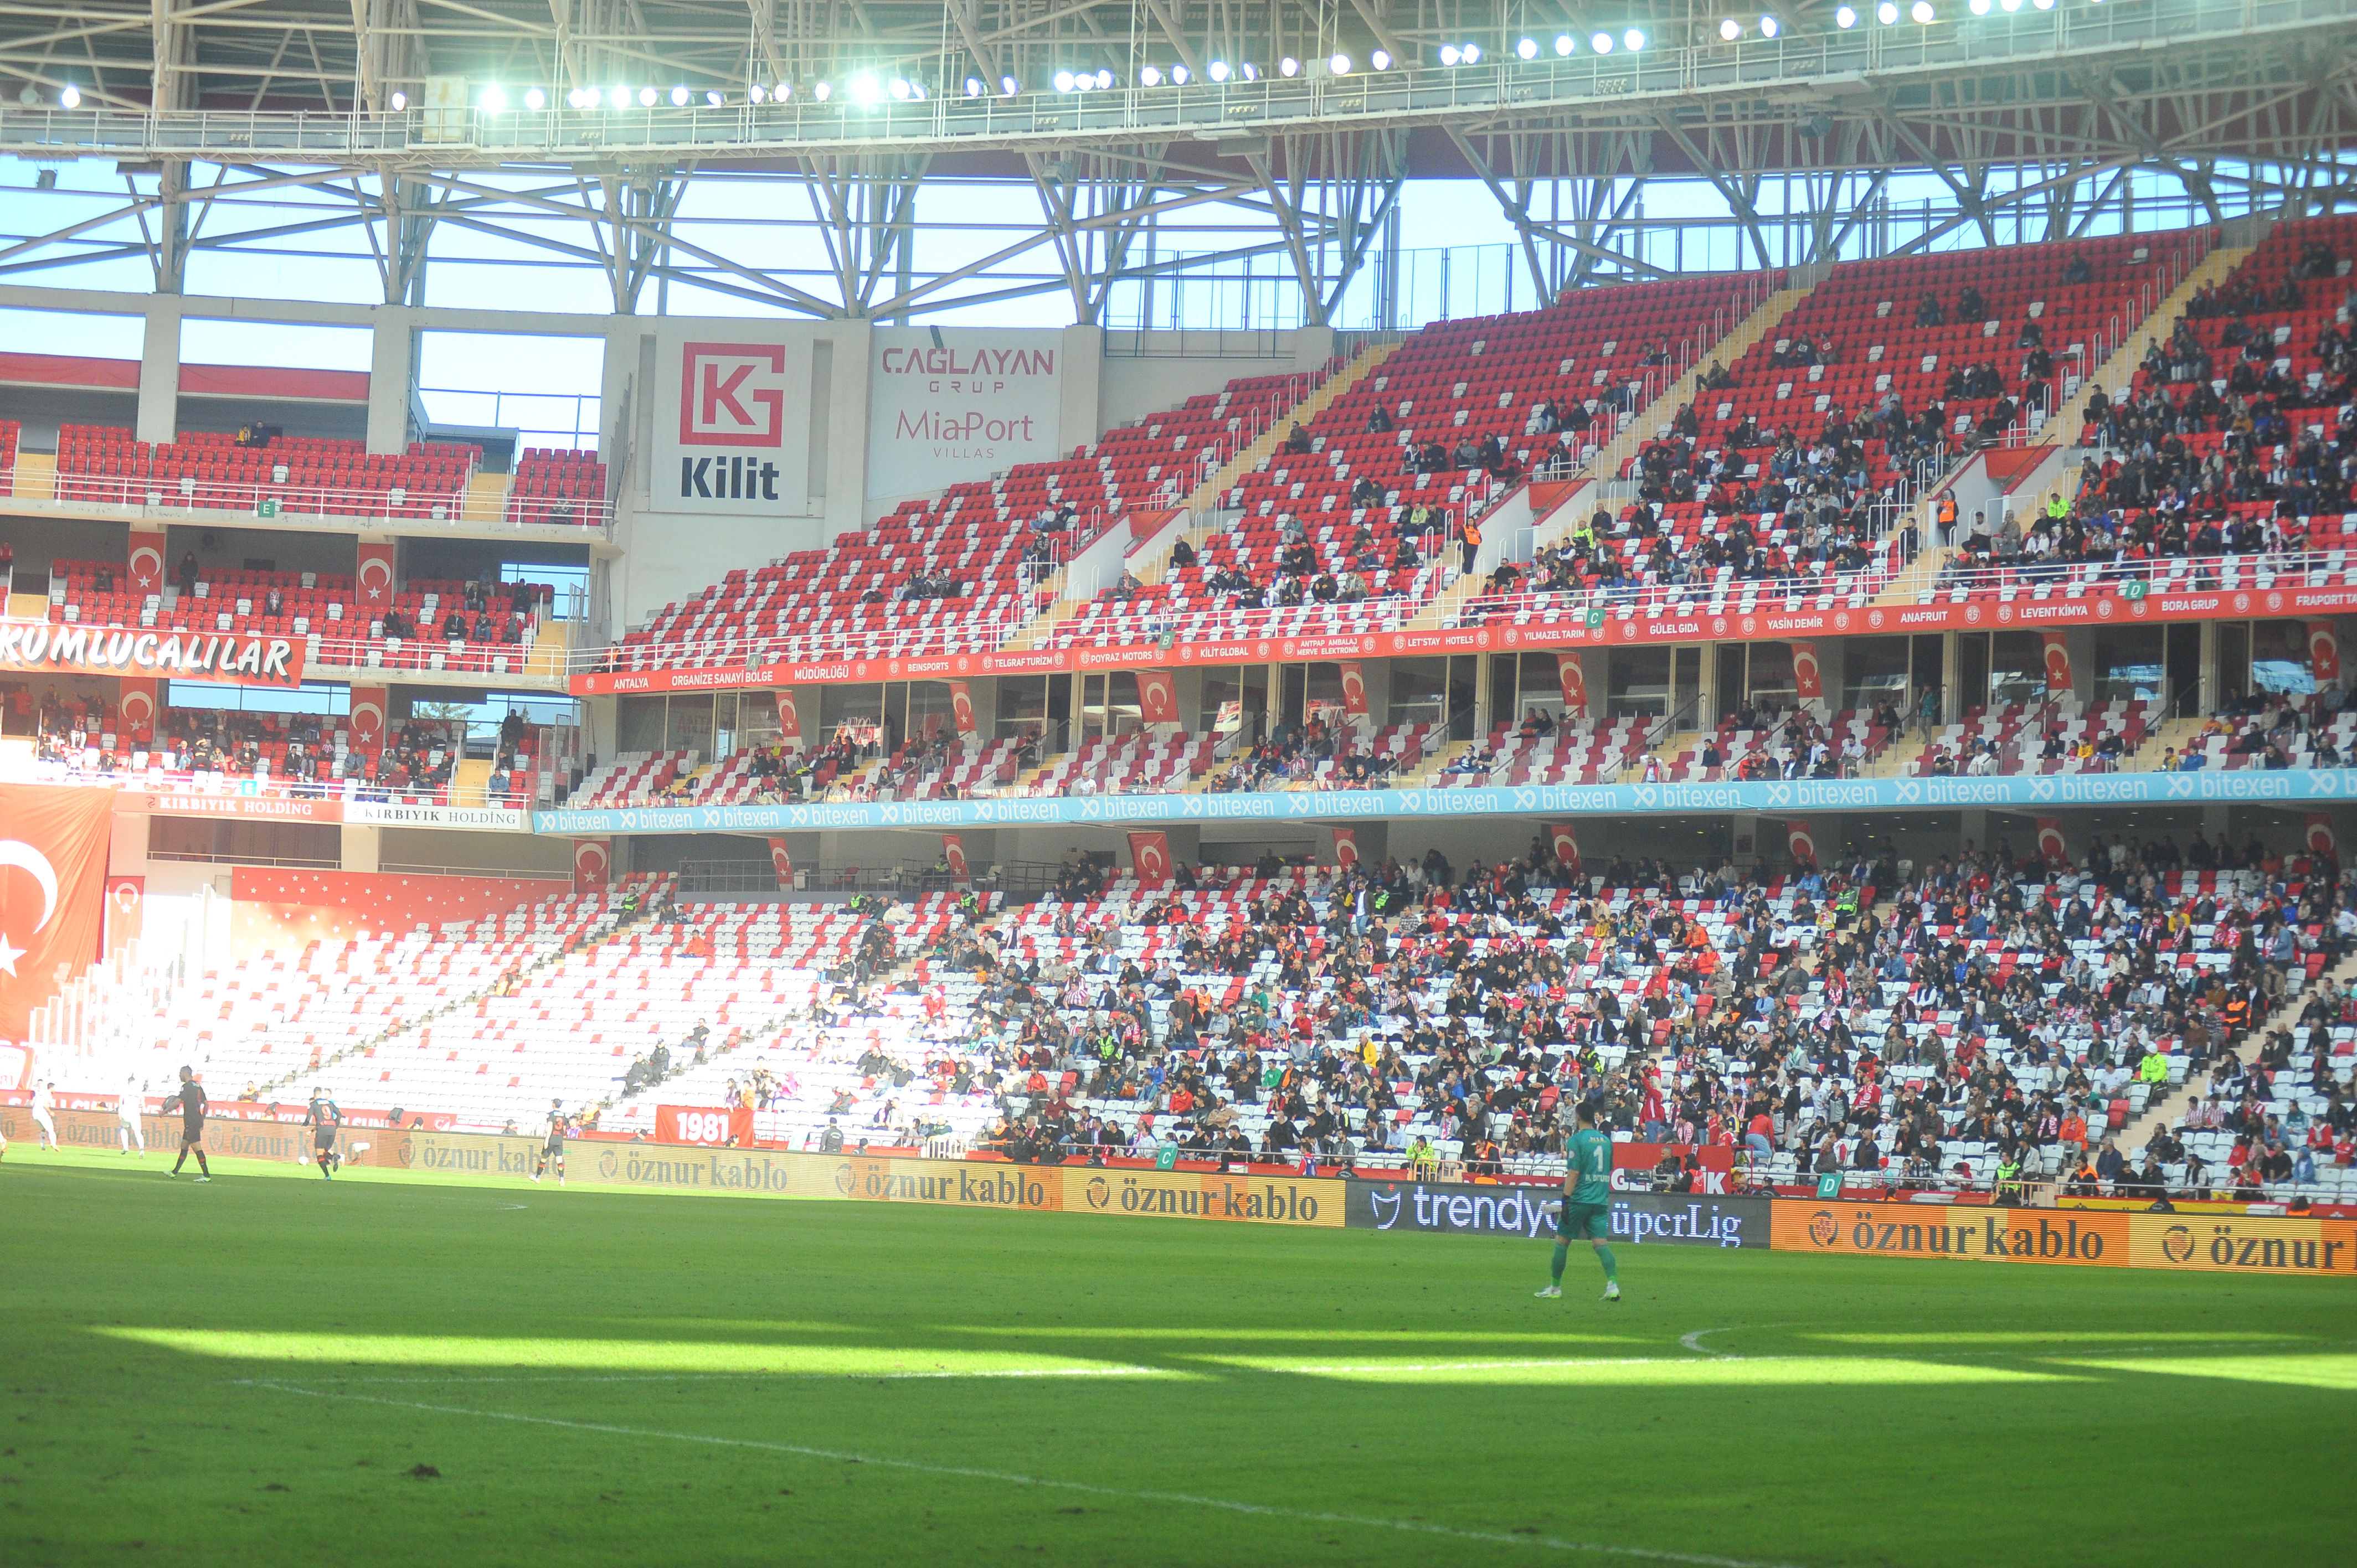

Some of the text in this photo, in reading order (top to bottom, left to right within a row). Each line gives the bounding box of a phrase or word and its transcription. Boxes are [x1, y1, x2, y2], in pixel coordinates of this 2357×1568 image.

[929, 380, 1004, 394] GRUP
[896, 409, 1034, 442] MiaPort
[933, 447, 994, 458] VILLAS
[681, 455, 780, 501] Kilit
[264, 504, 270, 513] E
[2130, 585, 2141, 596] D
[2162, 599, 2219, 611] BORA GRUP
[2296, 594, 2344, 606] FRAPORT
[1591, 612, 1599, 624] C
[1900, 611, 1948, 623] ANAFRUIT
[2020, 604, 2087, 619] LEVENT KİMYA
[1650, 622, 1699, 635] GÜLEL GIDA
[1767, 615, 1823, 631] YASİN DEMİR
[1162, 636, 1170, 646] B
[1328, 638, 1357, 646] AMBALAJ
[1445, 635, 1474, 646] HOTELS
[1524, 630, 1585, 641] YILMAZEL TARIM
[1090, 651, 1152, 664] POYRAZ MOTORS
[1200, 646, 1249, 658] KİLİT GLOBAL
[907, 662, 949, 672] BEINSPORTS
[994, 655, 1053, 668] TELGRAF TURİZM
[614, 665, 850, 690] ANTALYA ORGANİZE SANAYİ BÖLGE MÜDÜRLÜĞÜ
[159, 796, 313, 816] KIRBIYIK HOLDİNG
[559, 773, 2290, 831] bitexen bitexen bitexen bitexen bitexen bitexen bitexen bitexen bitexen bitexen bitexen bitexen bitexen bitexen bitexen bitexen
[449, 810, 516, 824] HOLDİNG
[322, 1105, 331, 1121] 9
[554, 1117, 563, 1130] 3
[676, 1112, 729, 1142] 1981
[230, 1127, 294, 1157] öznur
[423, 1138, 493, 1171] öznur
[1162, 1152, 1171, 1164] C
[1593, 1146, 1604, 1172] 1
[626, 1151, 788, 1191] öznur kablo
[866, 1164, 1044, 1206] öznur kablo
[1824, 1178, 1835, 1192] D
[1121, 1177, 1318, 1221] öznur kablo
[1413, 1186, 1562, 1239] trendy
[1852, 1211, 2103, 1260] öznur kablo
[2210, 1224, 2344, 1270] öznur
